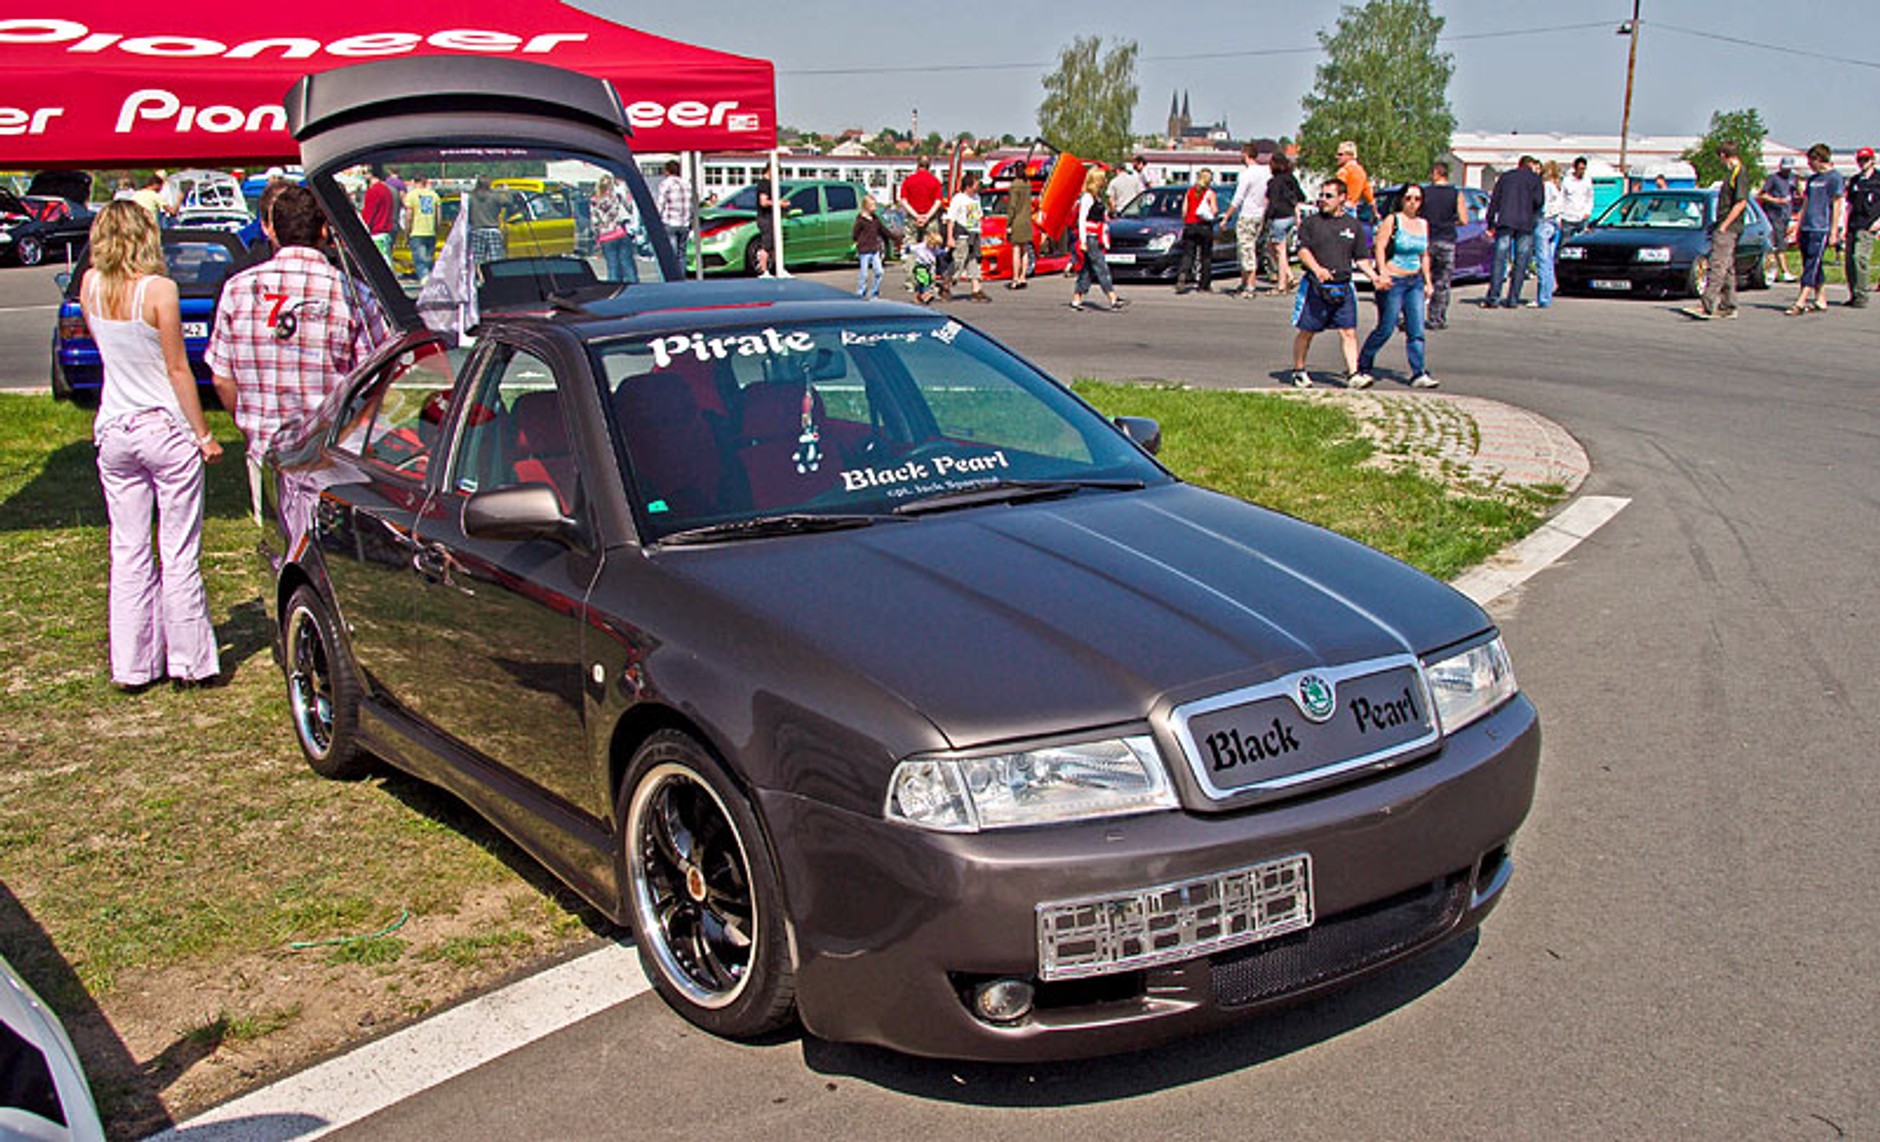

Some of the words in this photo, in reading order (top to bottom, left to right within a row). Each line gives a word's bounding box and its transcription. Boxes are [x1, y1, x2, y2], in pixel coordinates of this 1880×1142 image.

[0, 18, 588, 58] Pioneer
[647, 328, 815, 367] Pirate
[840, 461, 929, 491] Black
[932, 450, 1009, 476] Pearl
[1206, 718, 1299, 772] Black
[1350, 687, 1420, 733] Pearl
